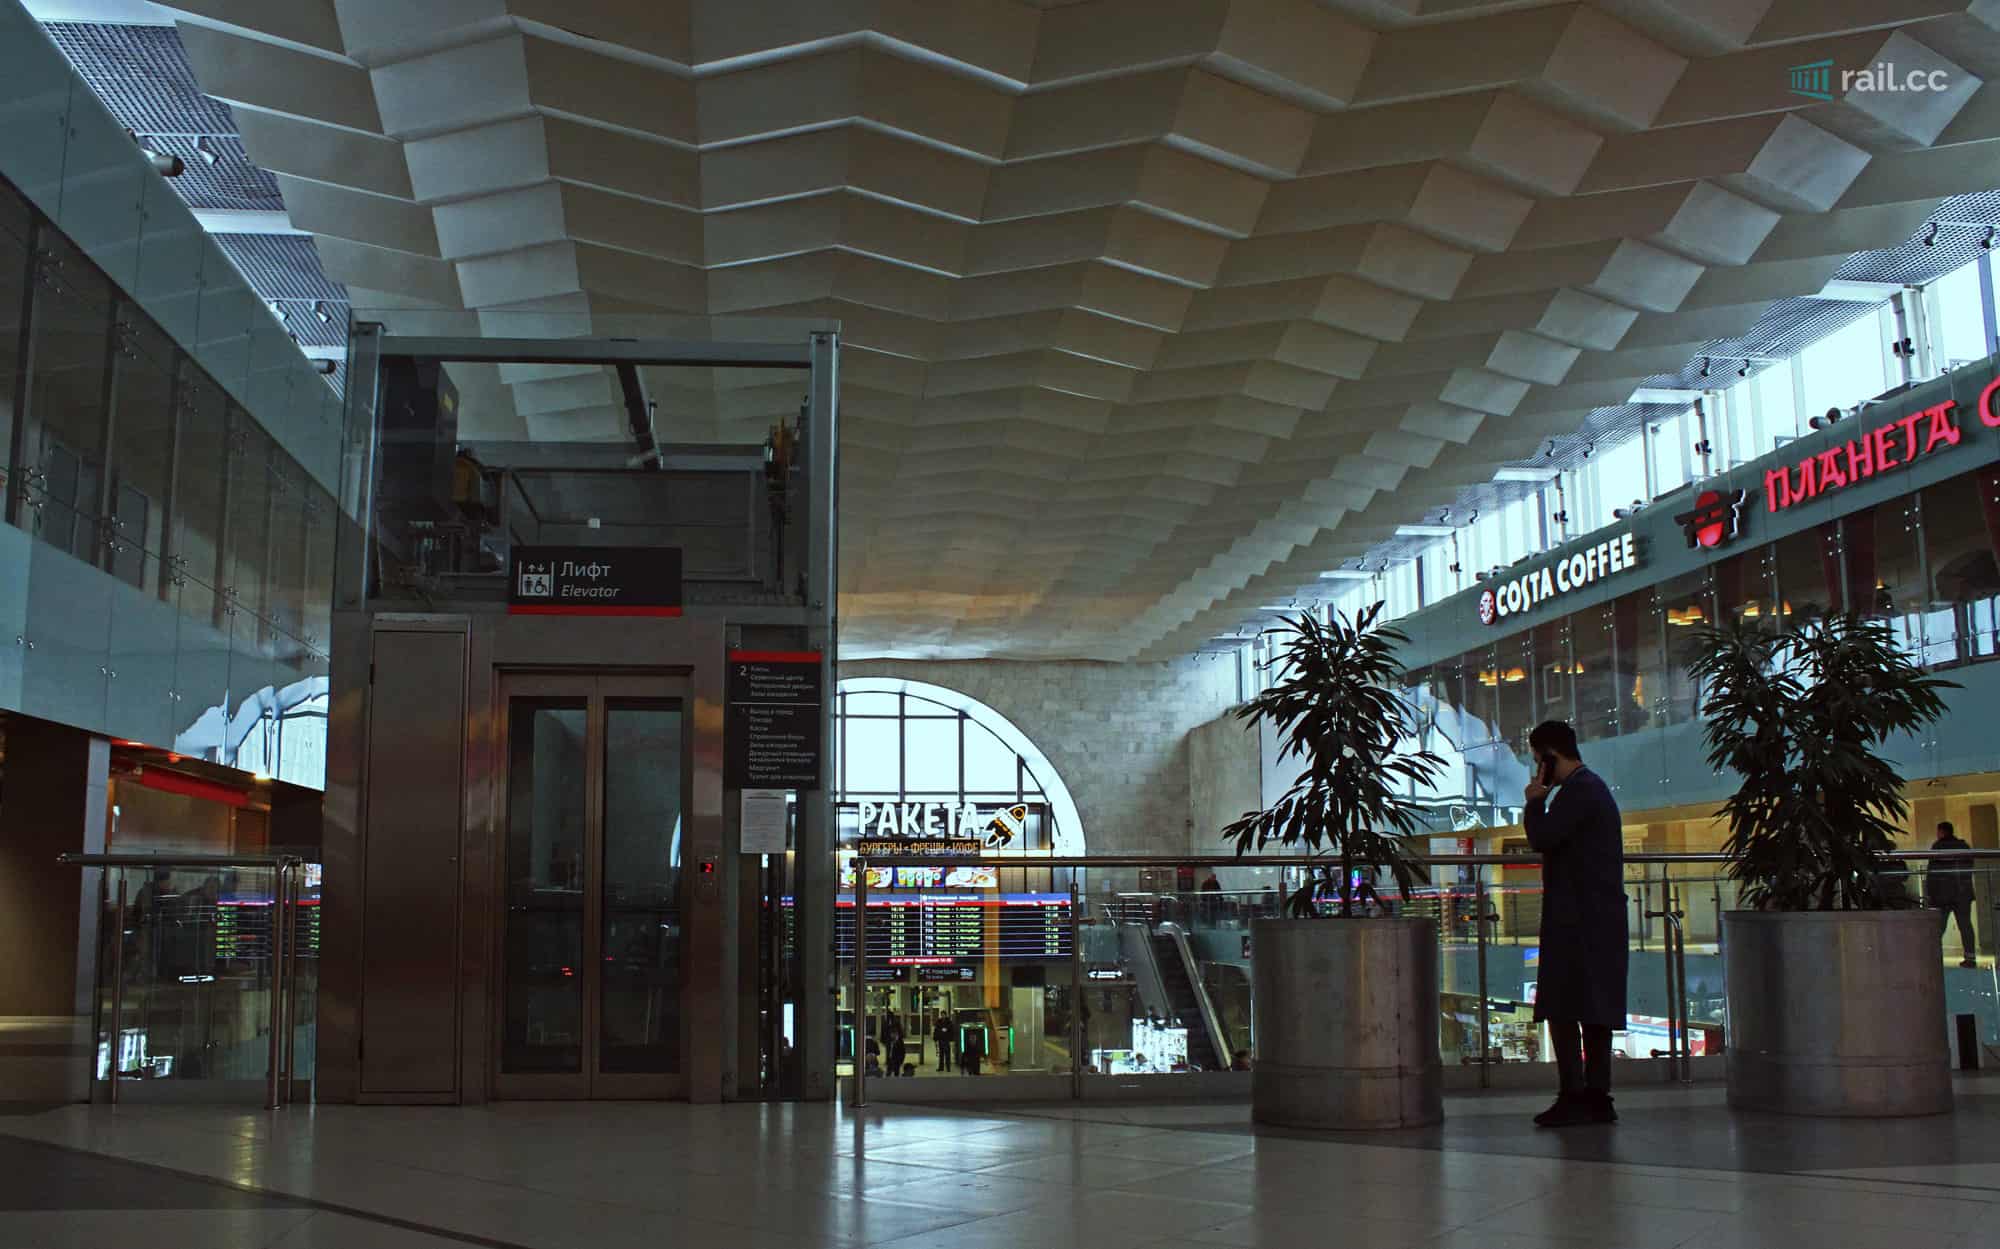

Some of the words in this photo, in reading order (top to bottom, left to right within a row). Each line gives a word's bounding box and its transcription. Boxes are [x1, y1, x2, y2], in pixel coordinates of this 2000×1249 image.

[1764, 400, 1962, 513] ПЛАНЕТА
[560, 561, 611, 582] Лифт
[1495, 567, 1555, 616] COSTA
[1556, 532, 1635, 593] COFFEE
[560, 584, 621, 598] Elevator
[739, 664, 747, 677] 2
[858, 801, 980, 836] РАКЕТА
